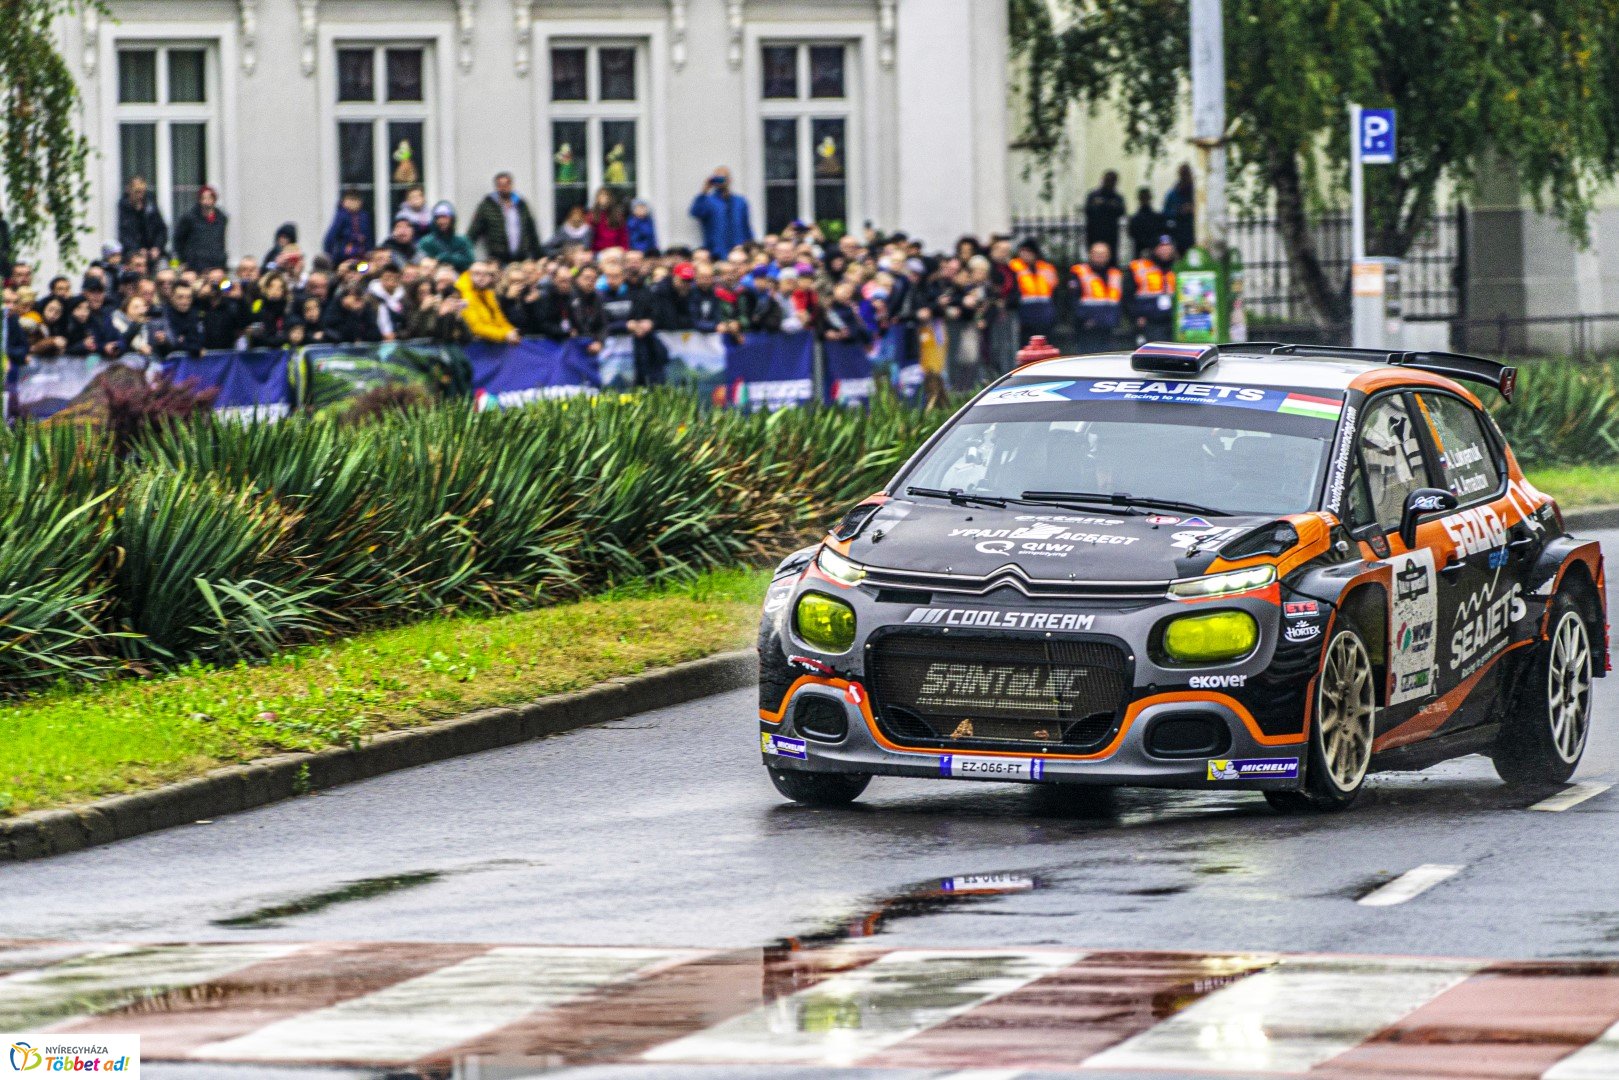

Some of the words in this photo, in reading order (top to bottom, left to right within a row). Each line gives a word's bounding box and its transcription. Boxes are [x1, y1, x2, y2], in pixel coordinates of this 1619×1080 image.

[1364, 115, 1389, 149] P
[1089, 380, 1267, 402] SEAJETS
[1124, 393, 1159, 401] Racing
[1175, 396, 1219, 404] summer
[947, 528, 1011, 538] УРАЛ
[1055, 532, 1141, 546] АСБЕСТ
[1021, 542, 1075, 552] QIWI
[1286, 602, 1317, 613] ETS
[945, 609, 1097, 631] COOLSTREAM
[1450, 582, 1527, 671] SEAJETS
[1285, 625, 1321, 638] HORTEX
[1188, 674, 1248, 688] ekover
[777, 740, 806, 753] MICHELIN
[961, 762, 1023, 774] EZ-066-FT
[1240, 763, 1298, 772] MICHELIN
